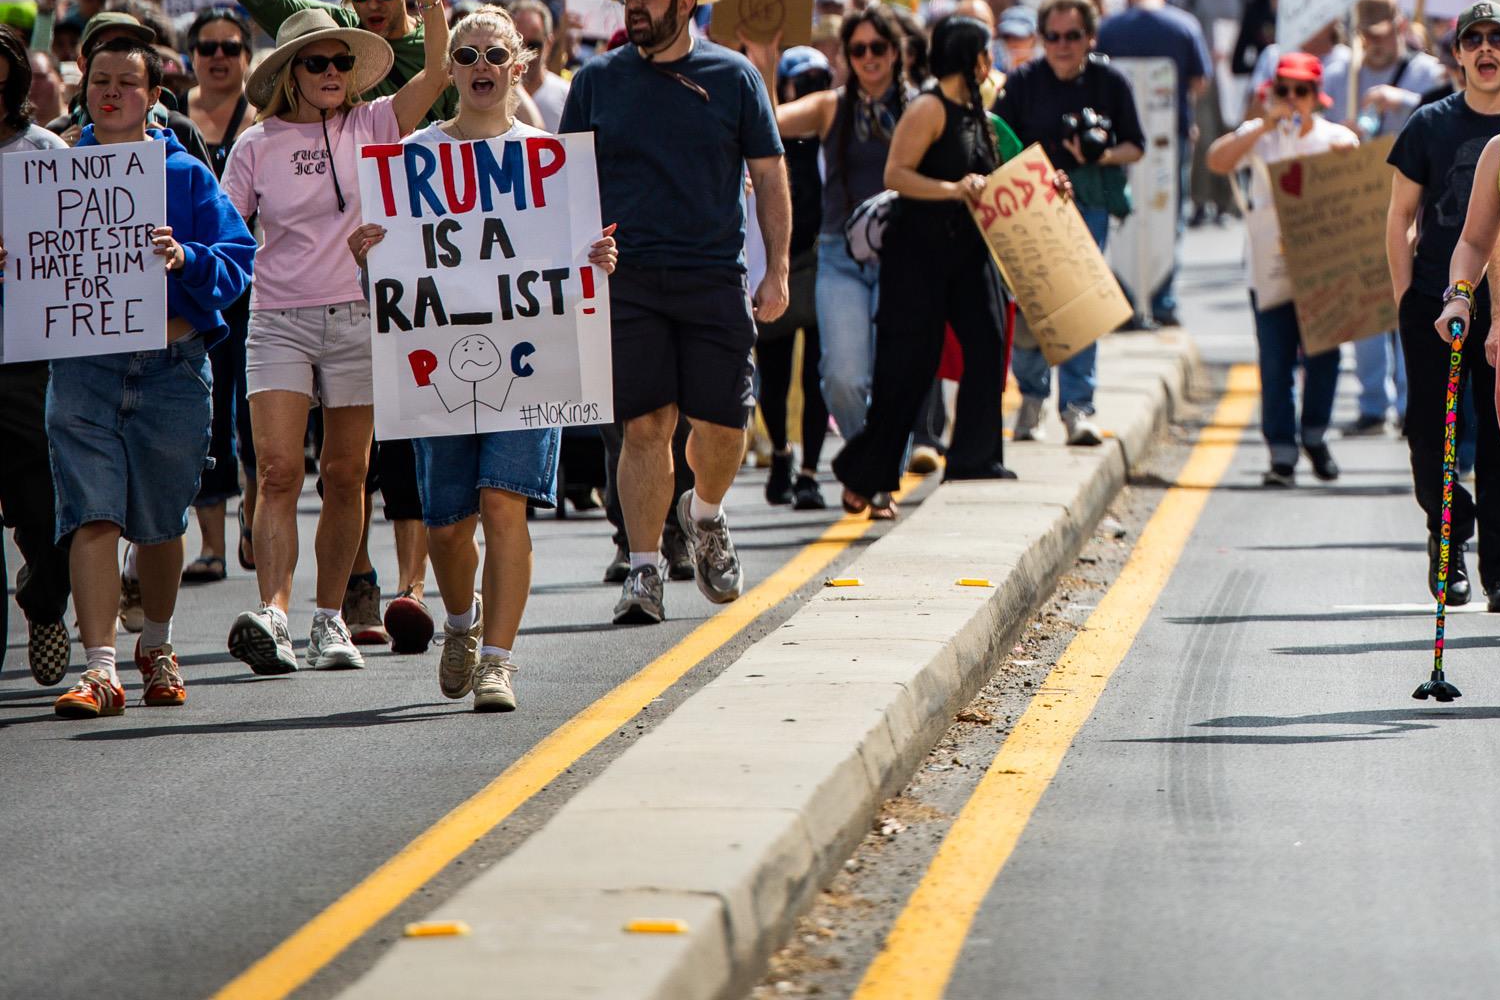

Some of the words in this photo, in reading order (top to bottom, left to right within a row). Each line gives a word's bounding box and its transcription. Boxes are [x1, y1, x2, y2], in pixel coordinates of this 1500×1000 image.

[25, 159, 57, 184] I'M
[72, 154, 116, 181] NOT
[126, 152, 144, 175] A
[290, 149, 329, 162] FUCK
[294, 162, 326, 176] ICE
[361, 137, 566, 217] TRUMP
[58, 187, 135, 228] PAID
[29, 223, 156, 256] PROTESTER
[422, 219, 463, 268] IS
[480, 218, 515, 259] A
[16, 258, 21, 280] I
[31, 254, 83, 279] HATE
[97, 251, 144, 274] HIM
[65, 276, 112, 300] FOR
[45, 299, 144, 338] FREE
